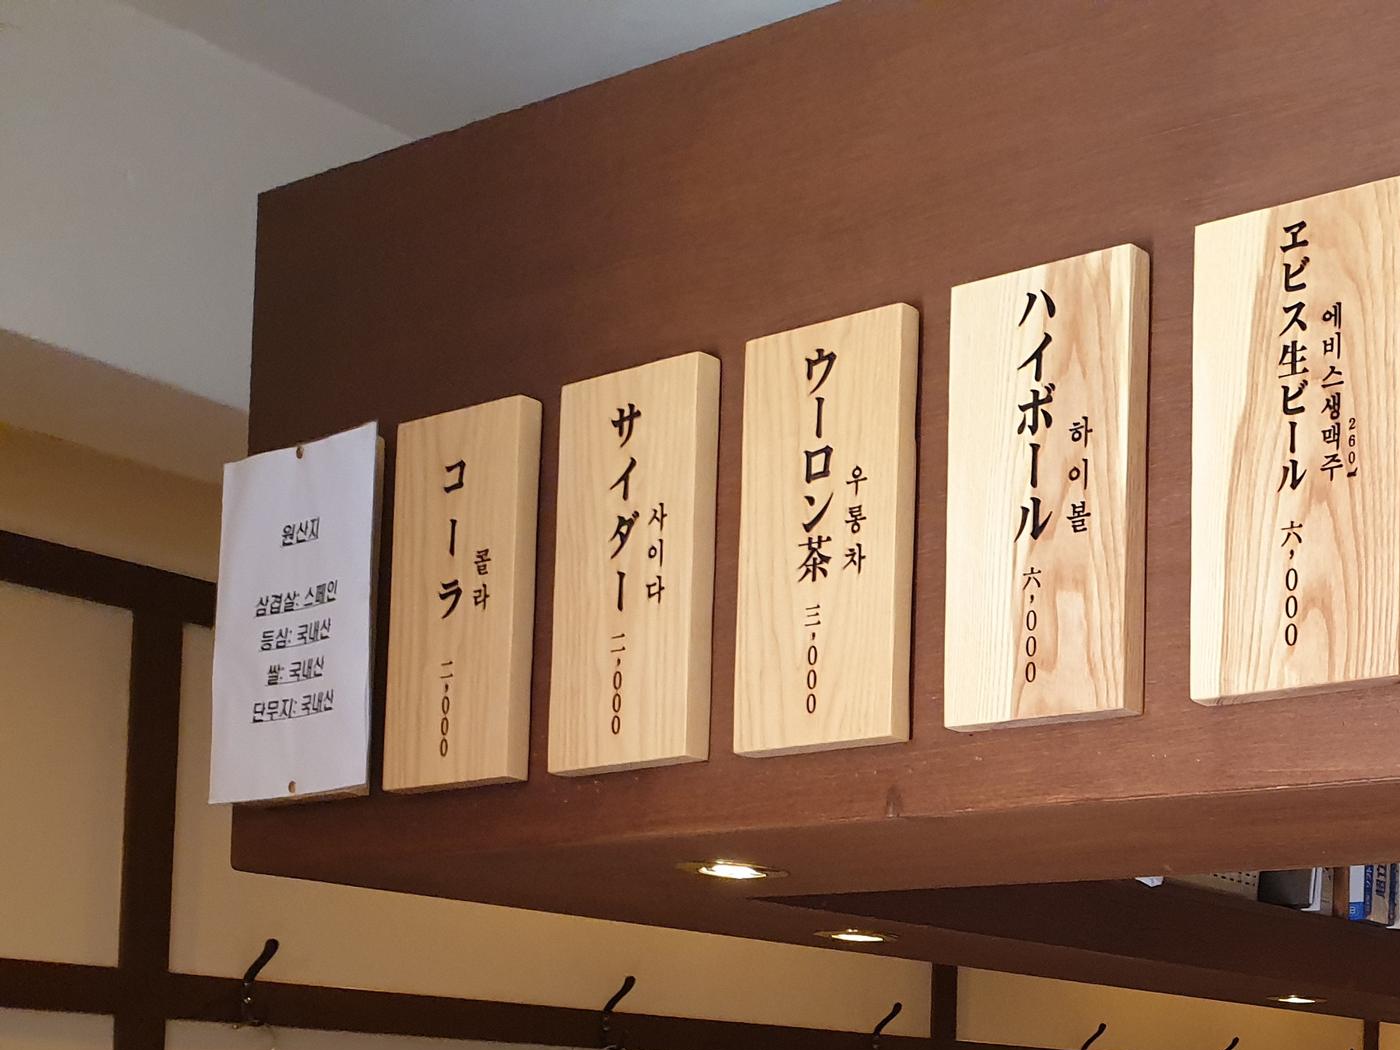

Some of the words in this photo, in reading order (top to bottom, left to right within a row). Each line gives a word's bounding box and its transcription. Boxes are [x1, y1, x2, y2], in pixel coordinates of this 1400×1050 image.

[1014, 290, 1055, 542] ハイボール
[1320, 302, 1344, 481] 에비스생맥주
[610, 403, 641, 611] サイダー
[799, 349, 836, 582] ウーロン茶
[1067, 416, 1092, 533] 하이볼
[281, 517, 320, 547] 원산지
[439, 460, 466, 618] コーラ
[646, 503, 667, 603] 사이다
[844, 466, 867, 573] 우롱차
[255, 591, 299, 616] 삼겹살:
[304, 579, 338, 606] 스페인
[474, 549, 491, 609] 콜라
[260, 627, 292, 650] 등심:
[297, 617, 331, 645] 국내산
[267, 664, 284, 685] 쌀:
[289, 656, 324, 679] 국내산
[252, 698, 297, 723] 단무지:
[301, 689, 334, 713] 국내산
